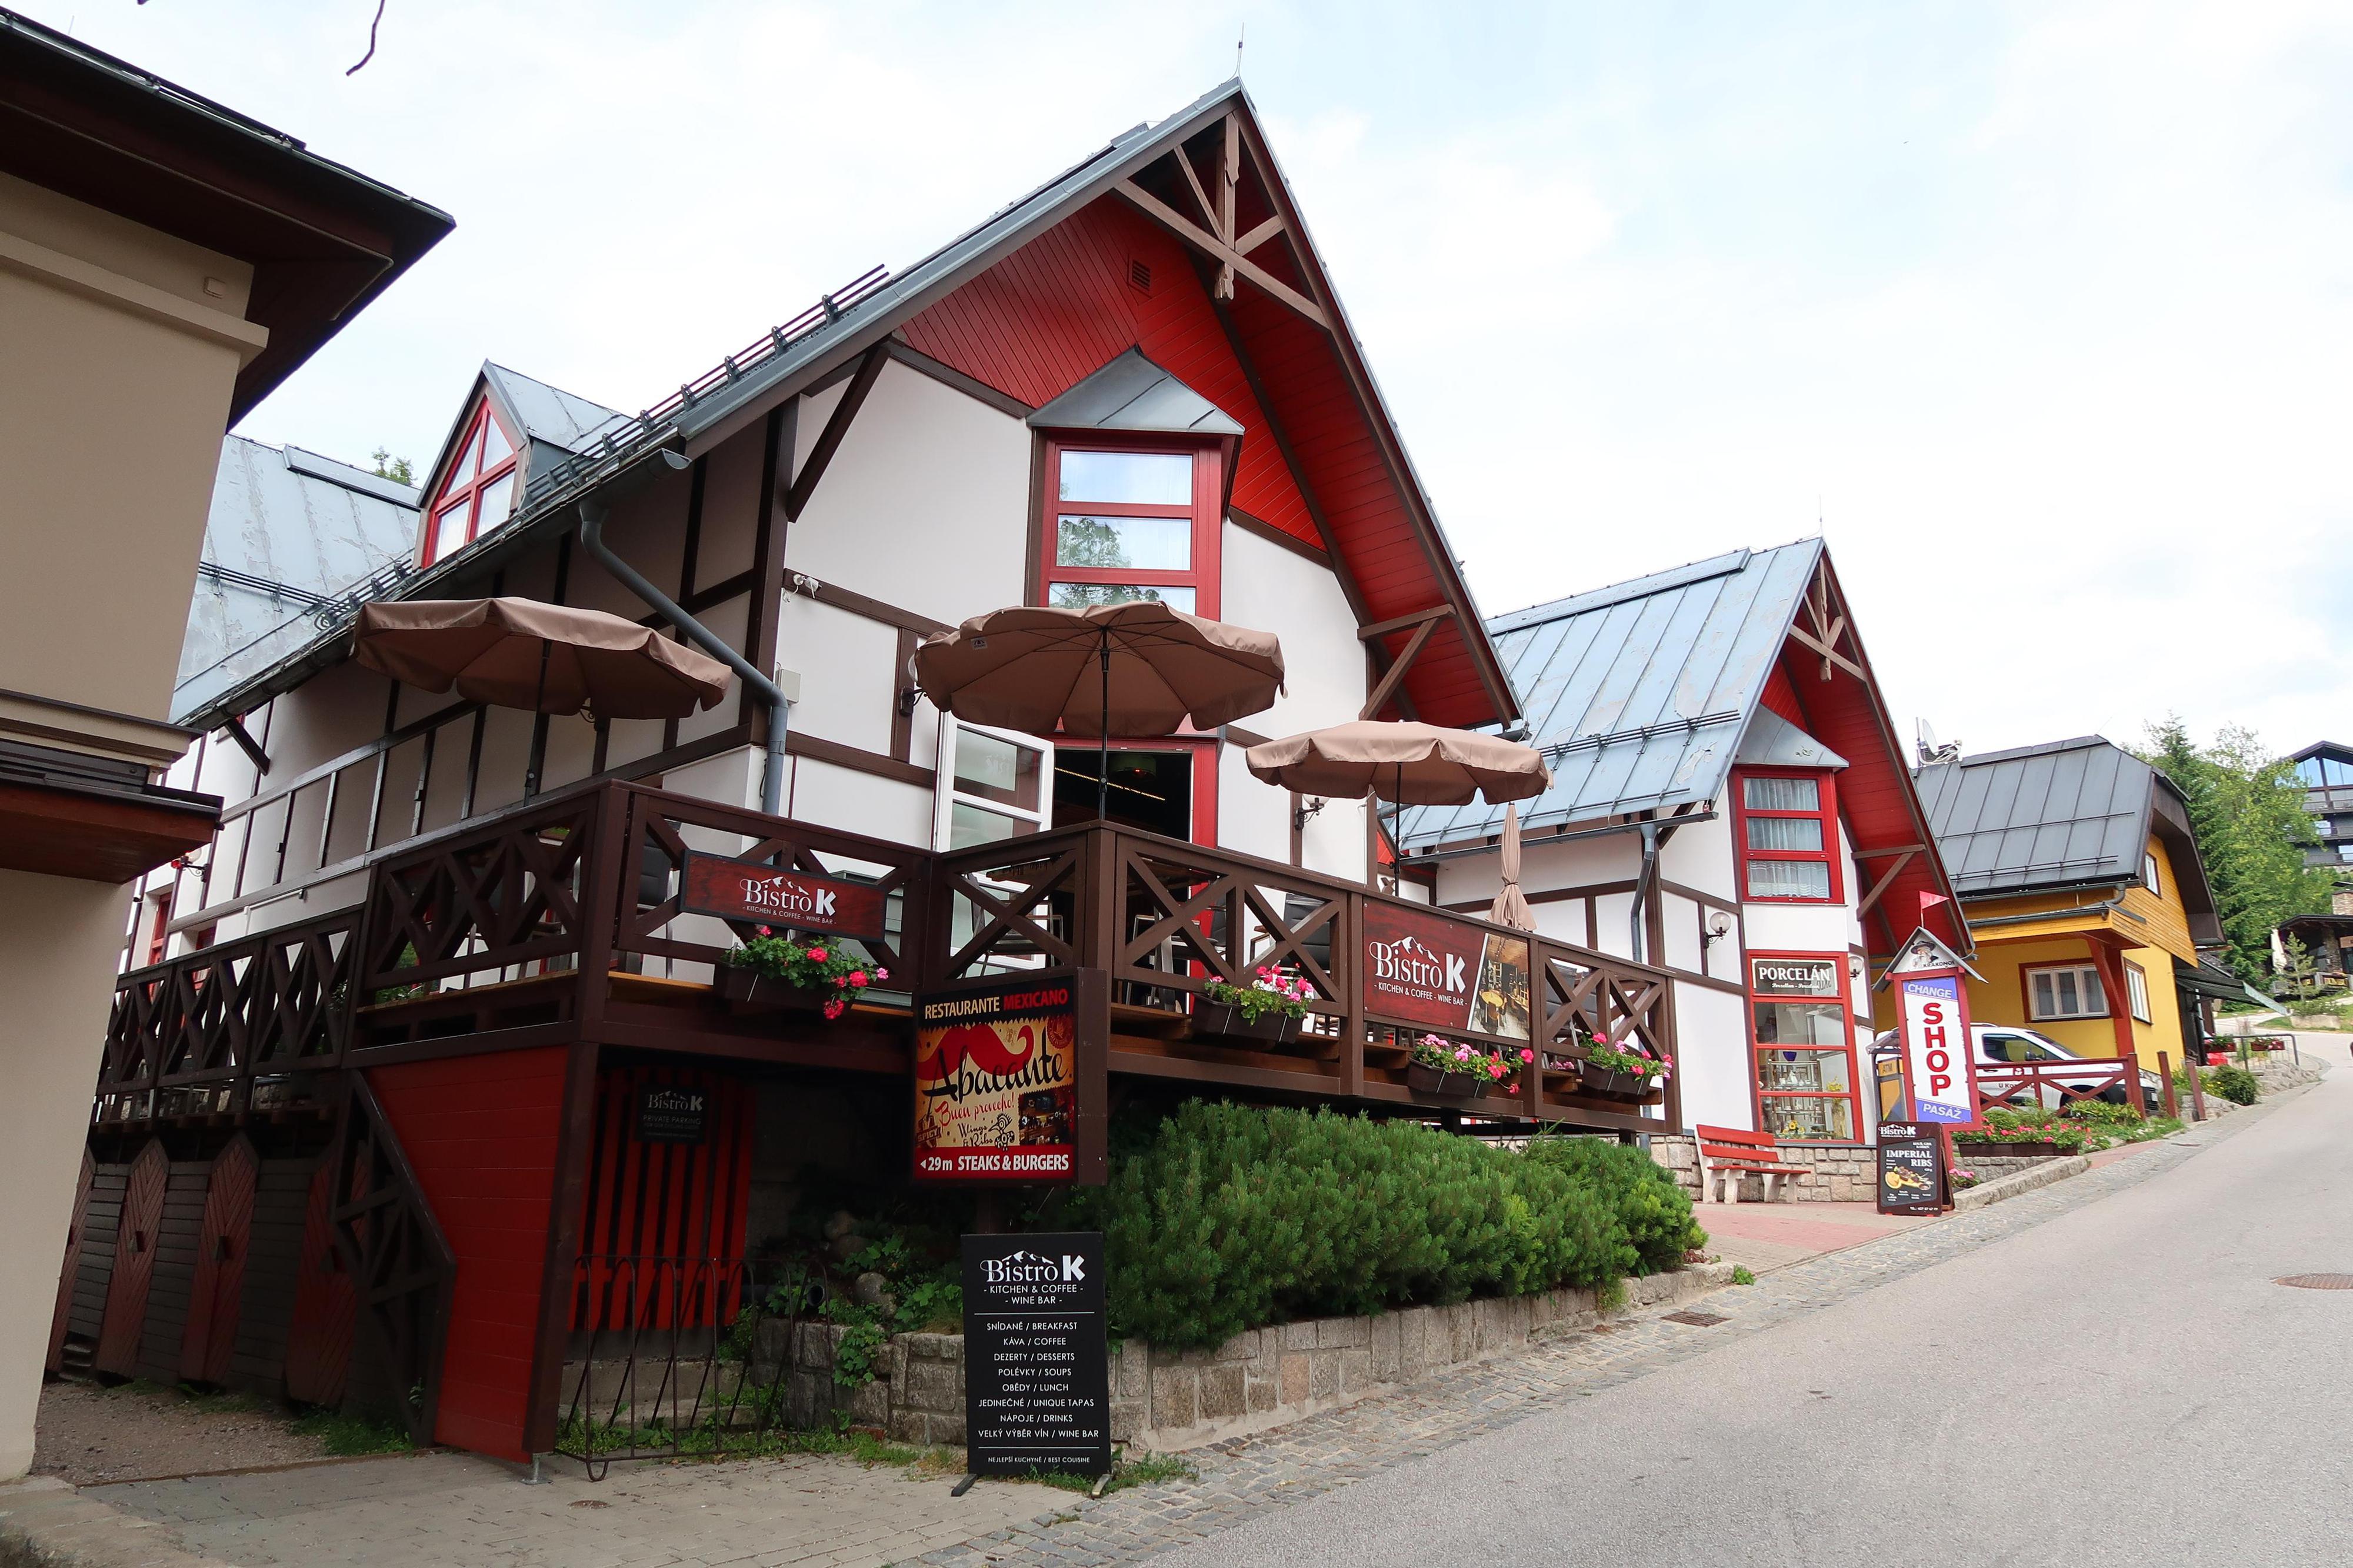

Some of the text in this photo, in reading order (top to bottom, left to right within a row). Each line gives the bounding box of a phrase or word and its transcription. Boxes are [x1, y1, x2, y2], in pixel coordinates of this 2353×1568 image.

[739, 879, 836, 916] Bistro K
[746, 906, 771, 915] KITCHEN
[779, 911, 801, 920] COFFEE
[1369, 942, 1466, 993] Bistro K
[1758, 965, 1831, 981] PORCELÁN
[1378, 982, 1404, 994] KITCHEN
[1411, 989, 1433, 1000] COFFEE
[1438, 994, 1452, 1004] WINE
[1453, 997, 1464, 1006] BAR
[1908, 984, 1952, 999] CHANGE
[925, 988, 1069, 1019] RESTAURANTE MEXICANO
[1922, 1002, 1951, 1097] SHOP
[922, 1026, 1068, 1106] Abacante
[690, 1095, 704, 1111] K
[935, 1092, 1015, 1127] Buen provecho!
[1923, 1103, 1962, 1119] PASÁŽ
[643, 1115, 702, 1125] PRIVATE PARKING
[917, 1129, 938, 1142] SPICY
[1907, 1126, 1916, 1135] K
[970, 1133, 994, 1147] Ribs
[1886, 1150, 1932, 1158] IMPERIAL
[958, 1156, 1000, 1171] STEAKS
[1014, 1155, 1069, 1171] BURGERS
[1911, 1159, 1933, 1167] RIBS
[980, 1255, 1085, 1282] Bistro K
[1041, 1285, 1077, 1293] COFFEE
[1012, 1296, 1035, 1305] WINE
[987, 1322, 1022, 1330] SNÍDANĚ
[1004, 1337, 1025, 1345] KÁVA
[999, 1367, 1035, 1376] POLÉVKY
[1002, 1383, 1030, 1391] OBĚDY
[979, 1397, 1024, 1406] JEDINEČNÉ
[1001, 1413, 1034, 1422] NÁPOJE
[978, 1429, 1002, 1437] VELKÝ
[1006, 1429, 1031, 1437] VÝBĚR
[1035, 1429, 1048, 1437] VÍN
